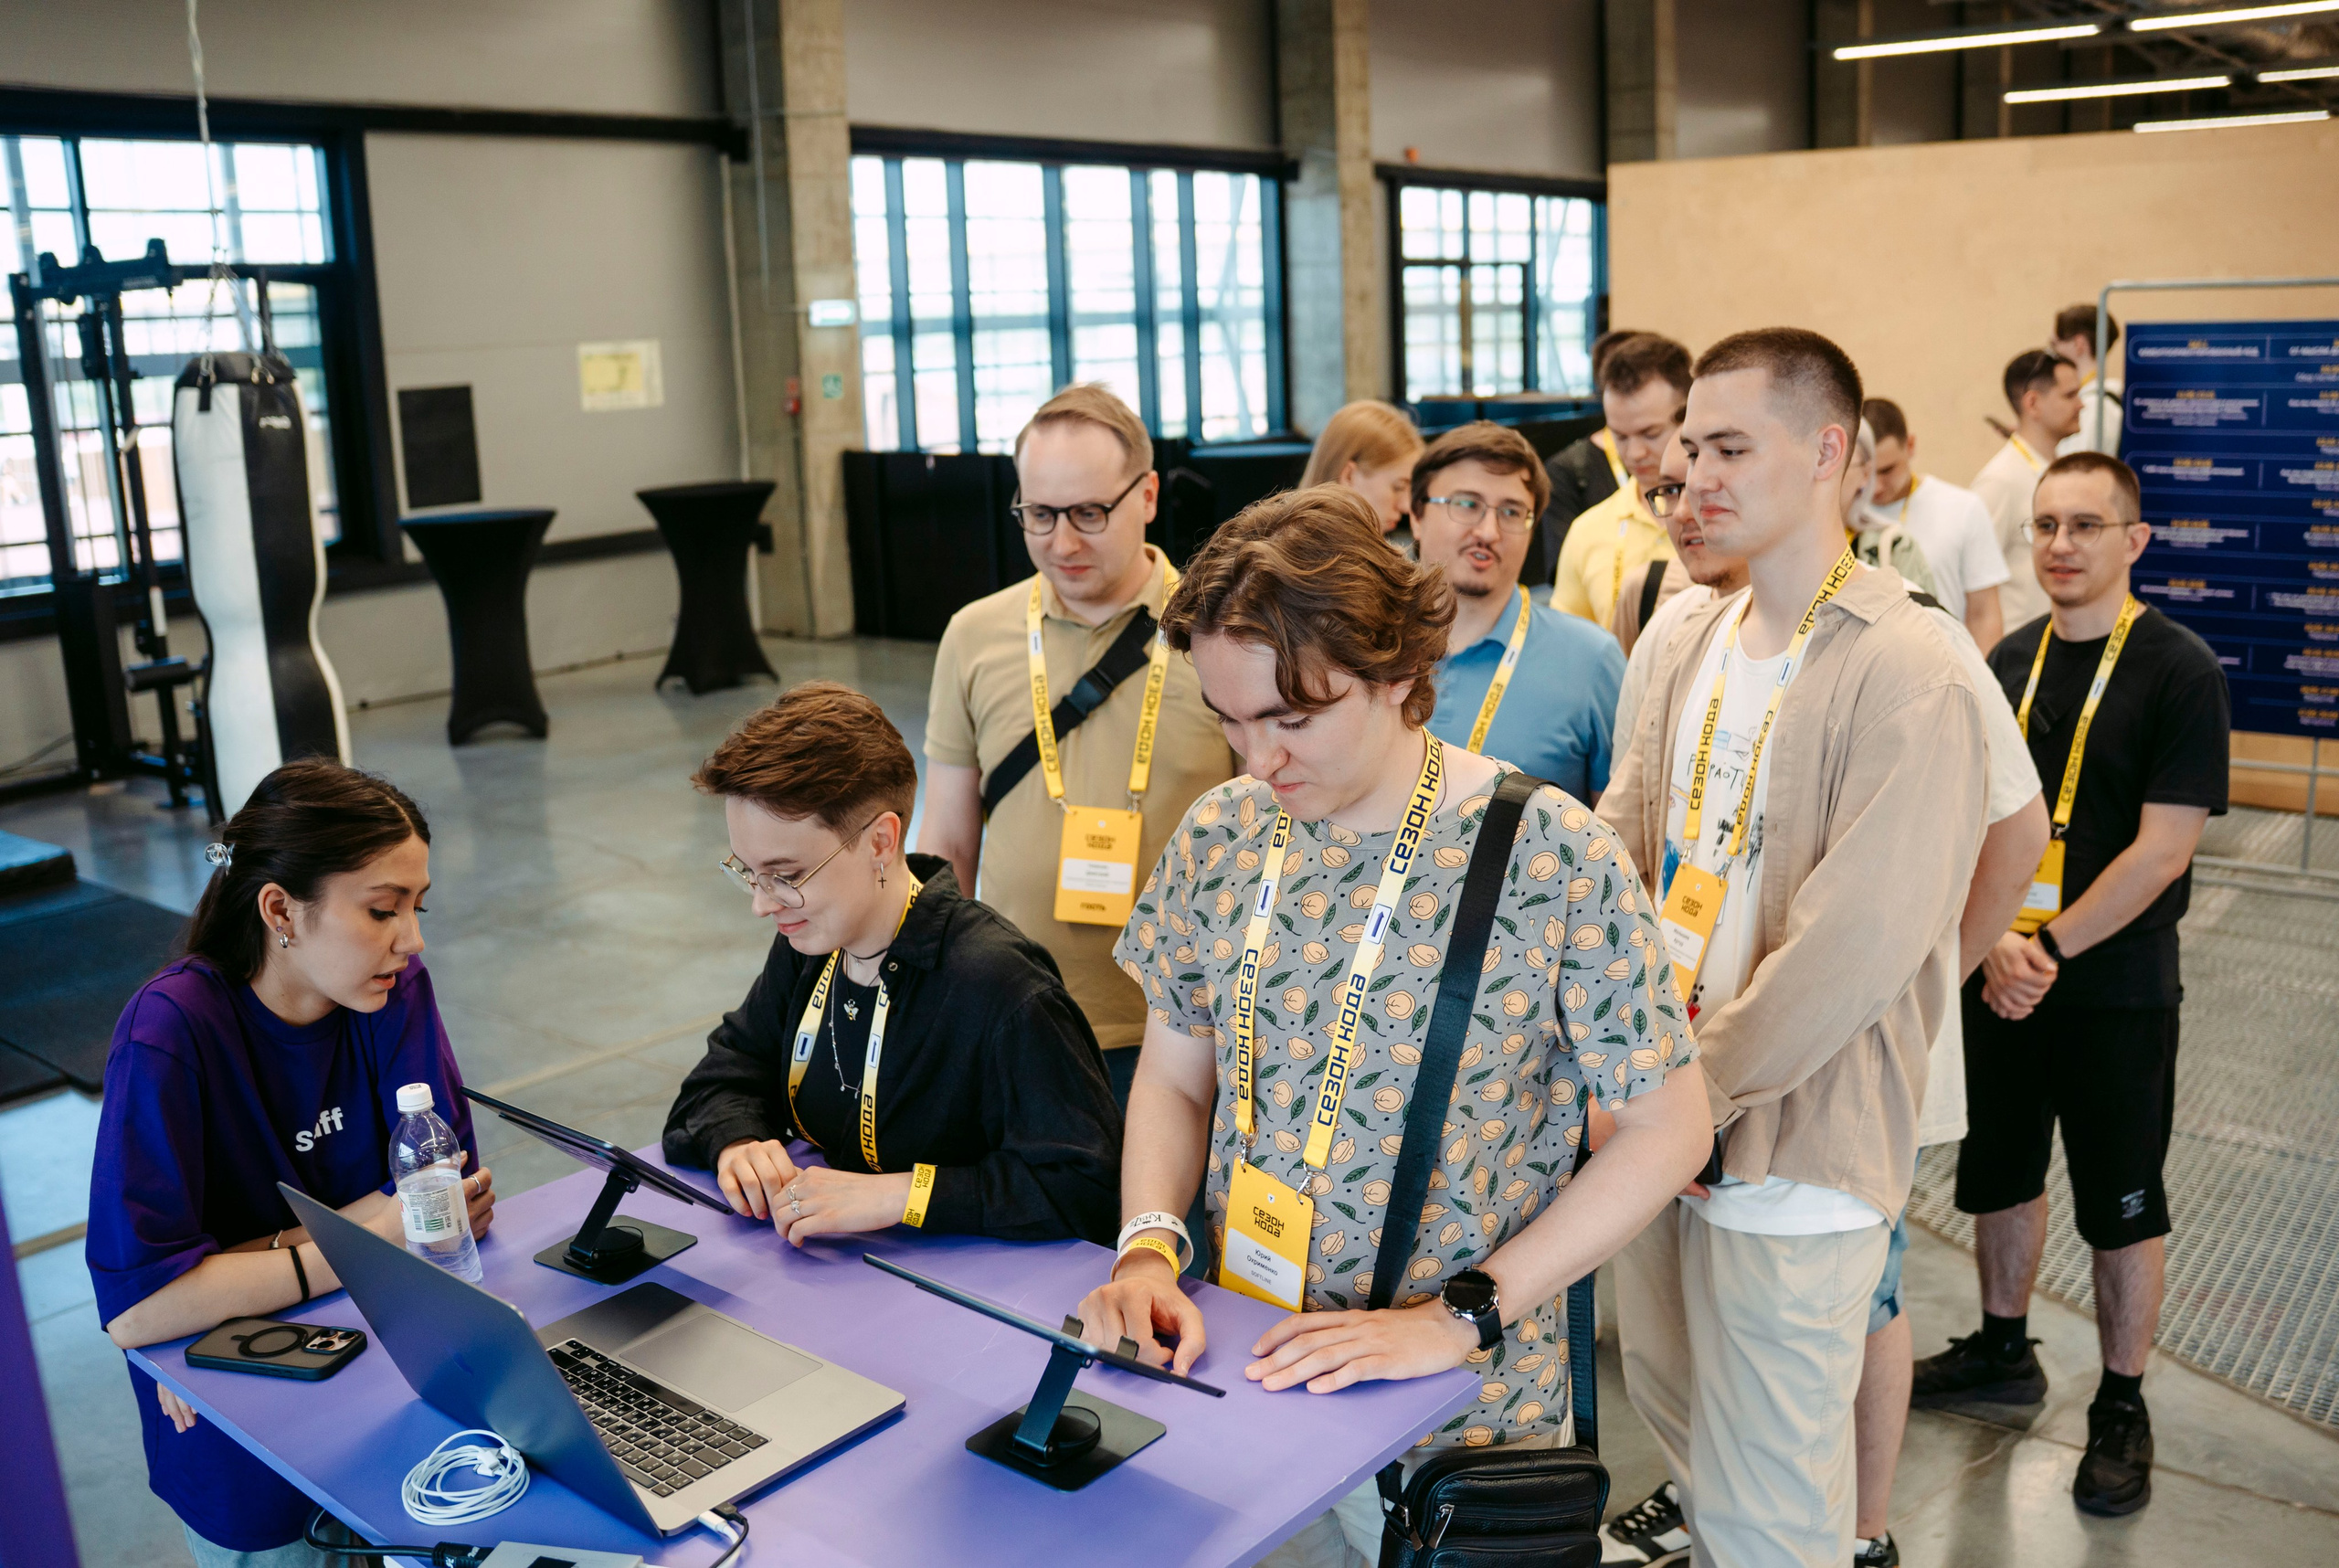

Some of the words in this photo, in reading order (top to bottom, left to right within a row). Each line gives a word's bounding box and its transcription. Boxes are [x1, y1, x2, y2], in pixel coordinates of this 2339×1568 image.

[1390, 794, 1432, 874] сезон
[1238, 948, 1258, 1030] сезон
[1237, 1034, 1250, 1101] кода
[1318, 1045, 1349, 1126] сезон
[1338, 973, 1366, 1042] кода
[1253, 1206, 1285, 1231] сезон
[1254, 1216, 1281, 1238] кода
[1255, 1248, 1271, 1262] Юрий
